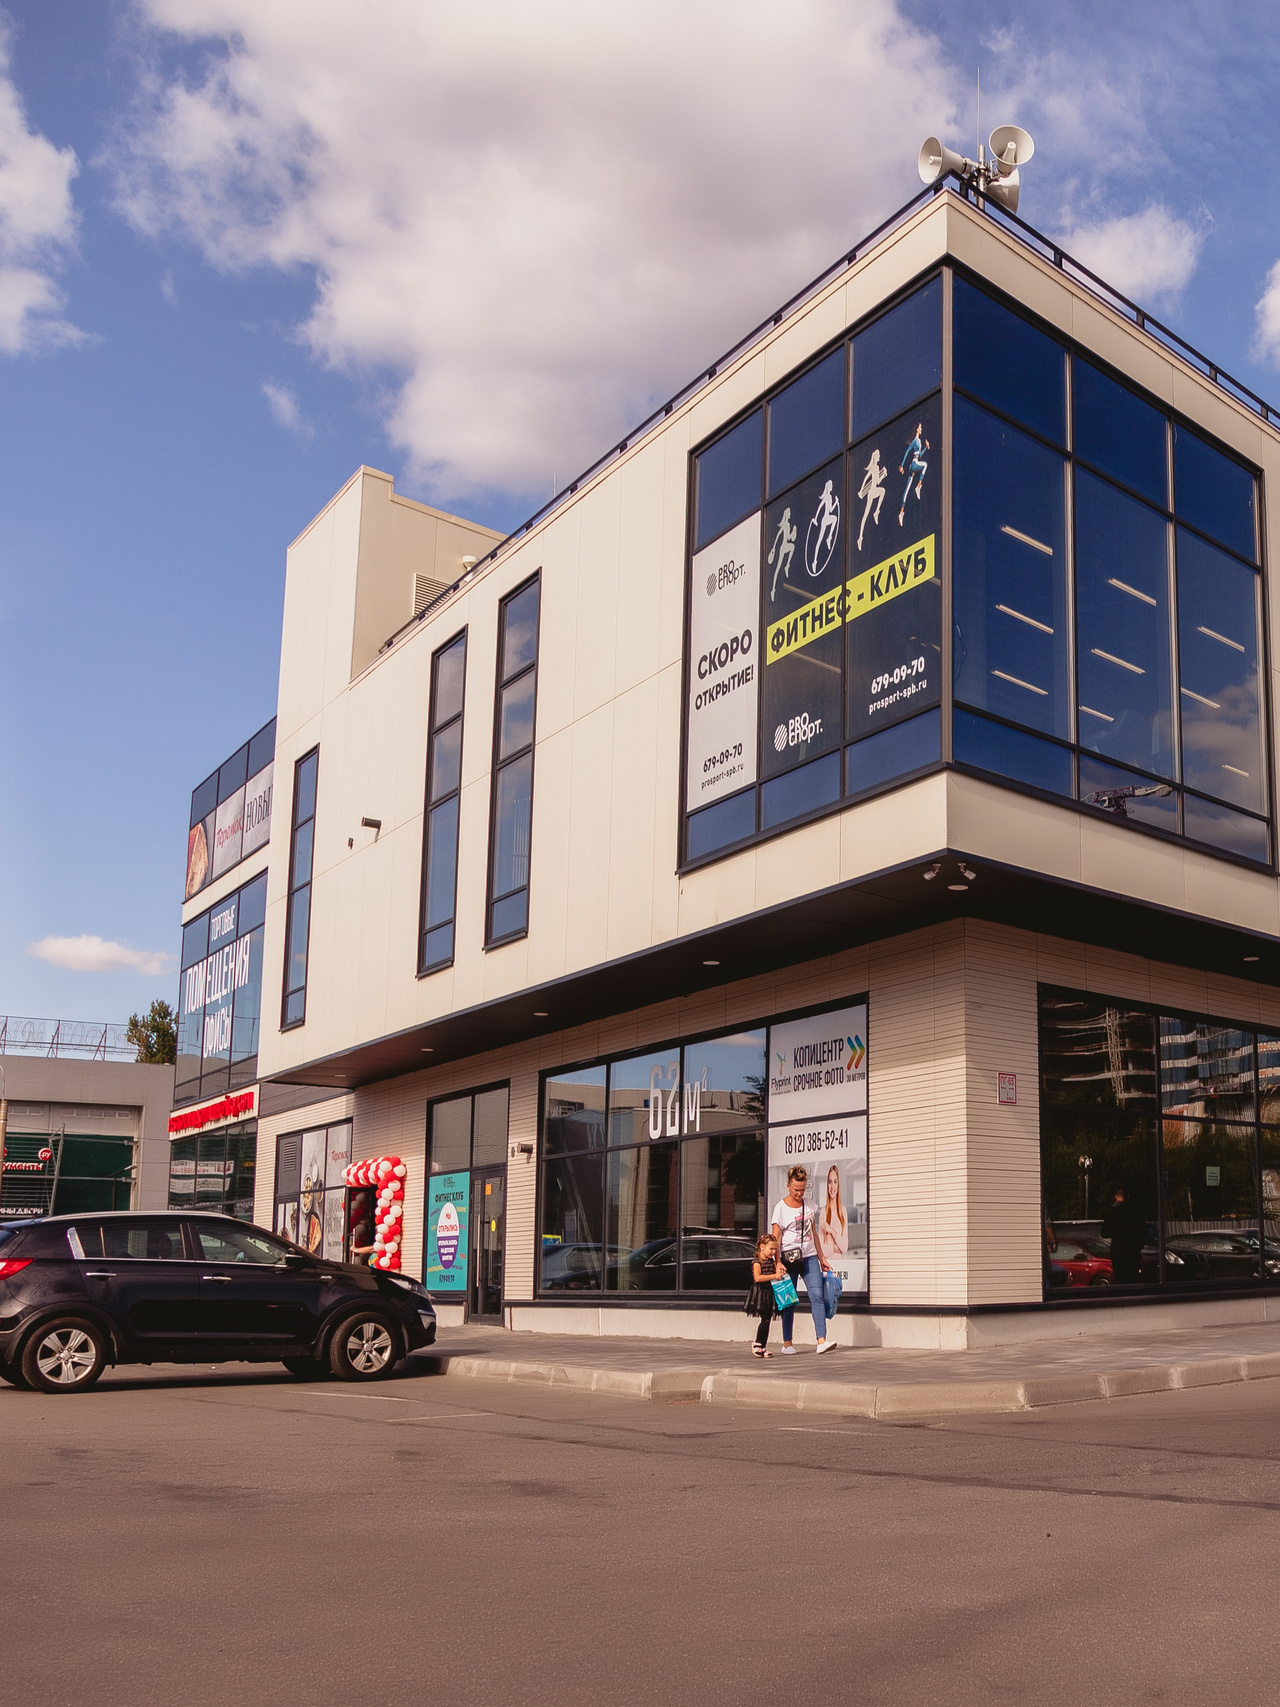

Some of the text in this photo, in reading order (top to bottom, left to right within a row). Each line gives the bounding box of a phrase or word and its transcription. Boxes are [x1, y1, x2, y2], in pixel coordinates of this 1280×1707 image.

[771, 589, 852, 653] ФИТНЕС
[870, 546, 927, 602] КЛУБ
[698, 629, 752, 680] СКОРО
[695, 664, 754, 711] ОТКРЫТИЕ!
[871, 656, 925, 695] 679-09-70
[869, 679, 927, 716] prosport-spb.ru
[703, 742, 743, 773] 679-09-70
[701, 763, 744, 791] prosport-spb.ru
[245, 784, 273, 834] НОВЫ
[211, 904, 235, 942] ТОРГОВЫЕ
[184, 933, 250, 1015] ПОМЕЩЕНИЯ
[203, 1004, 233, 1059] ОФИСЫ
[793, 1038, 844, 1069] КОПИЦЕНТР
[771, 1077, 792, 1091] Flyprint
[793, 1066, 844, 1092] СРОЧНОЕ ФОТО
[785, 1128, 849, 1154] (812) 385-52-41
